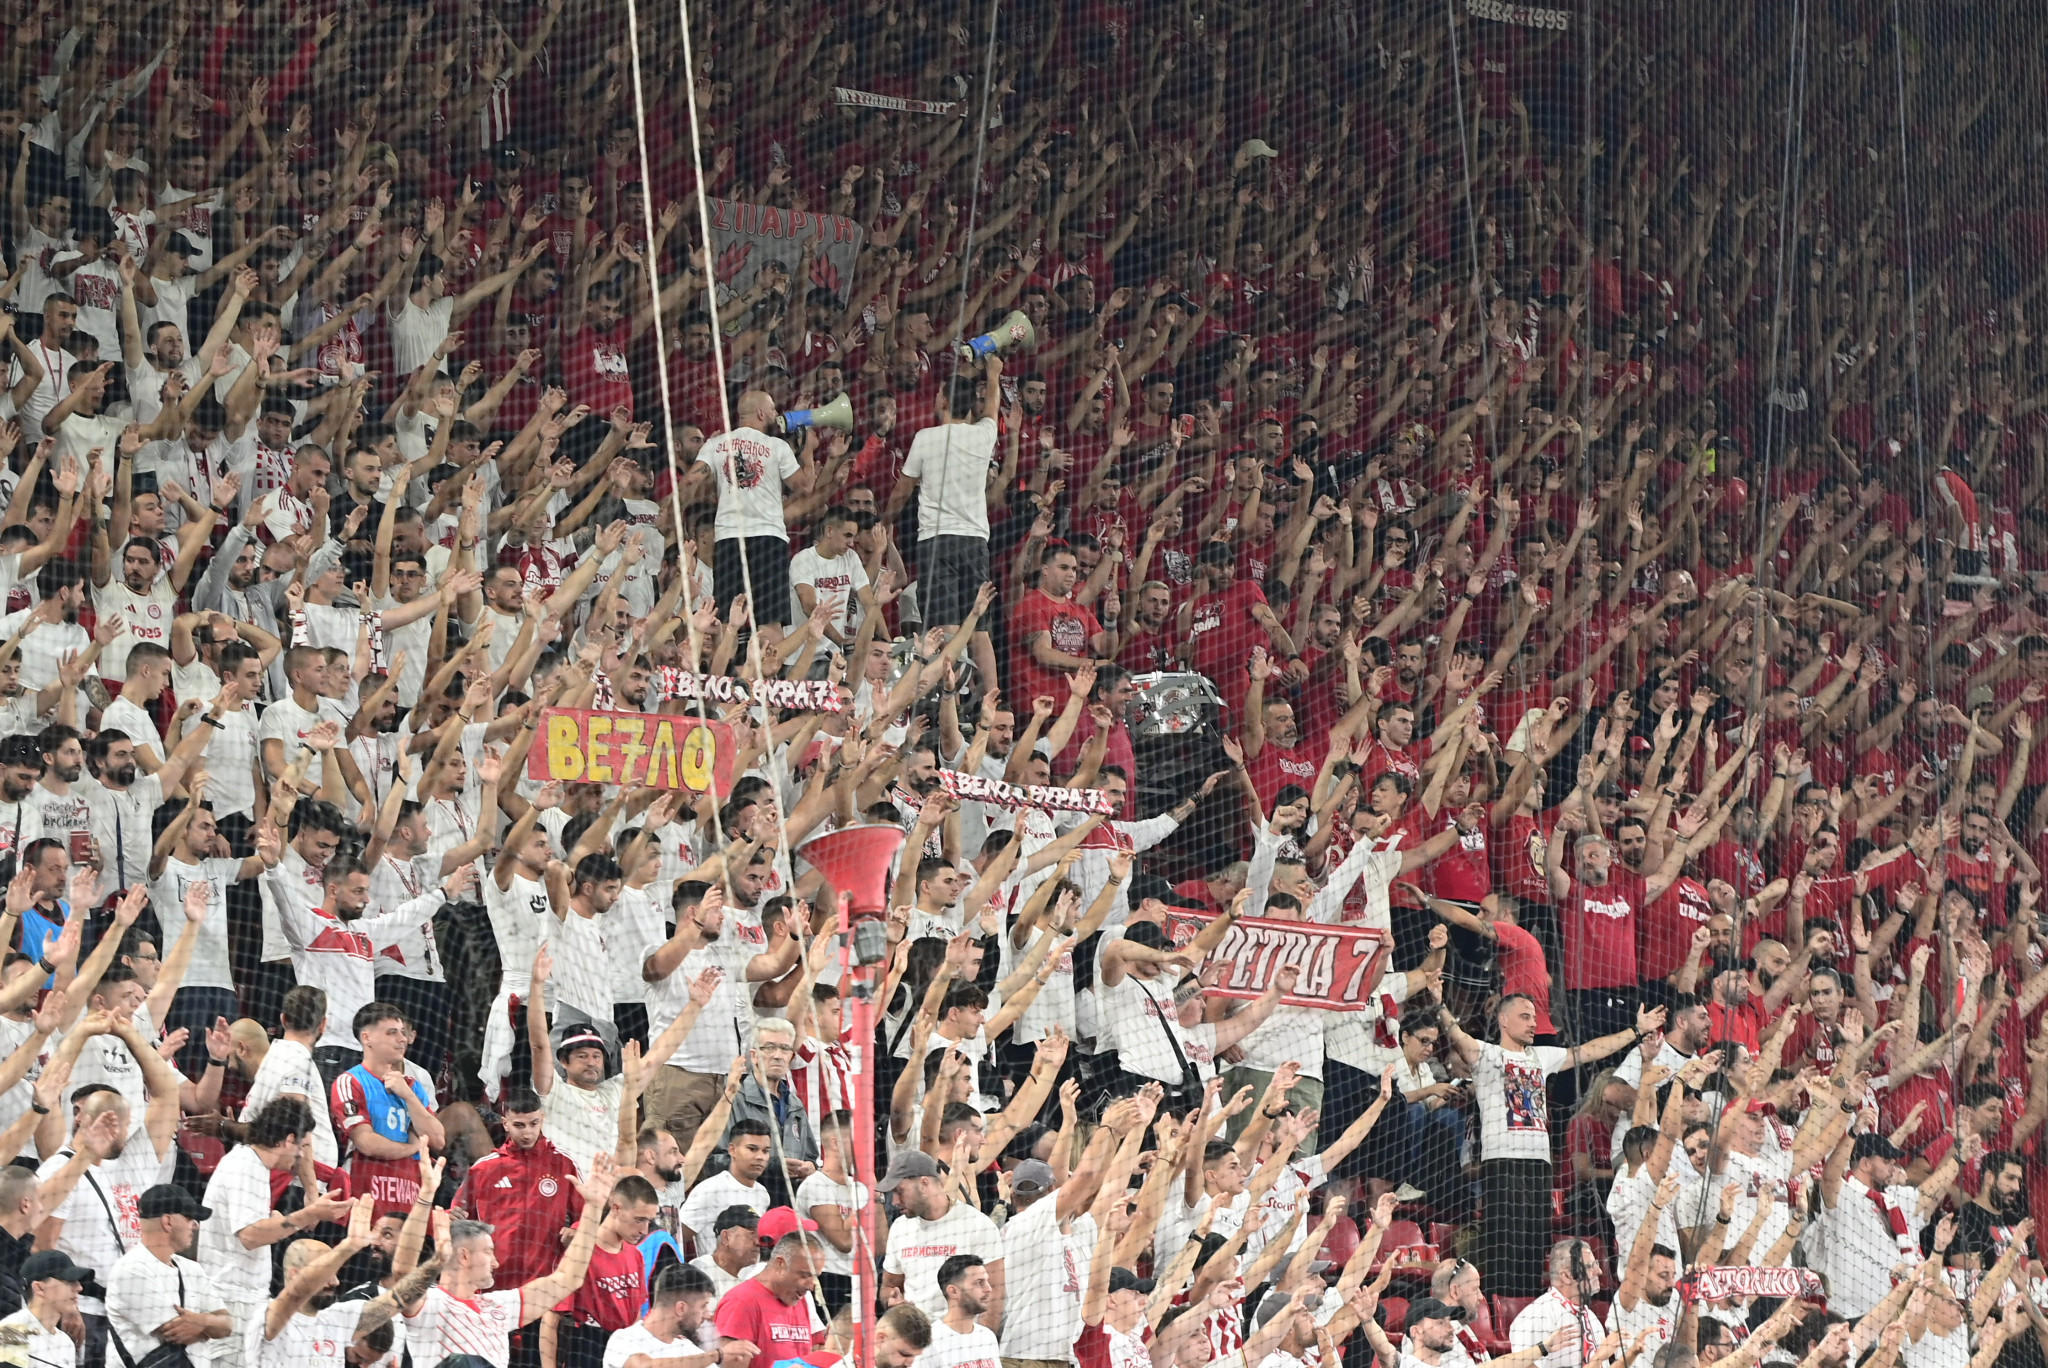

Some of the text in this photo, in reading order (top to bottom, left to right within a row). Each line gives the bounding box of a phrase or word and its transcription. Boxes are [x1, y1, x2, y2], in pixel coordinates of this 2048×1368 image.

[1529, 7, 1570, 31] 1995
[710, 198, 854, 245] ΣΠΑΡΤΗ
[1194, 923, 1380, 1001] ΡΕΤΡΙΑ 7
